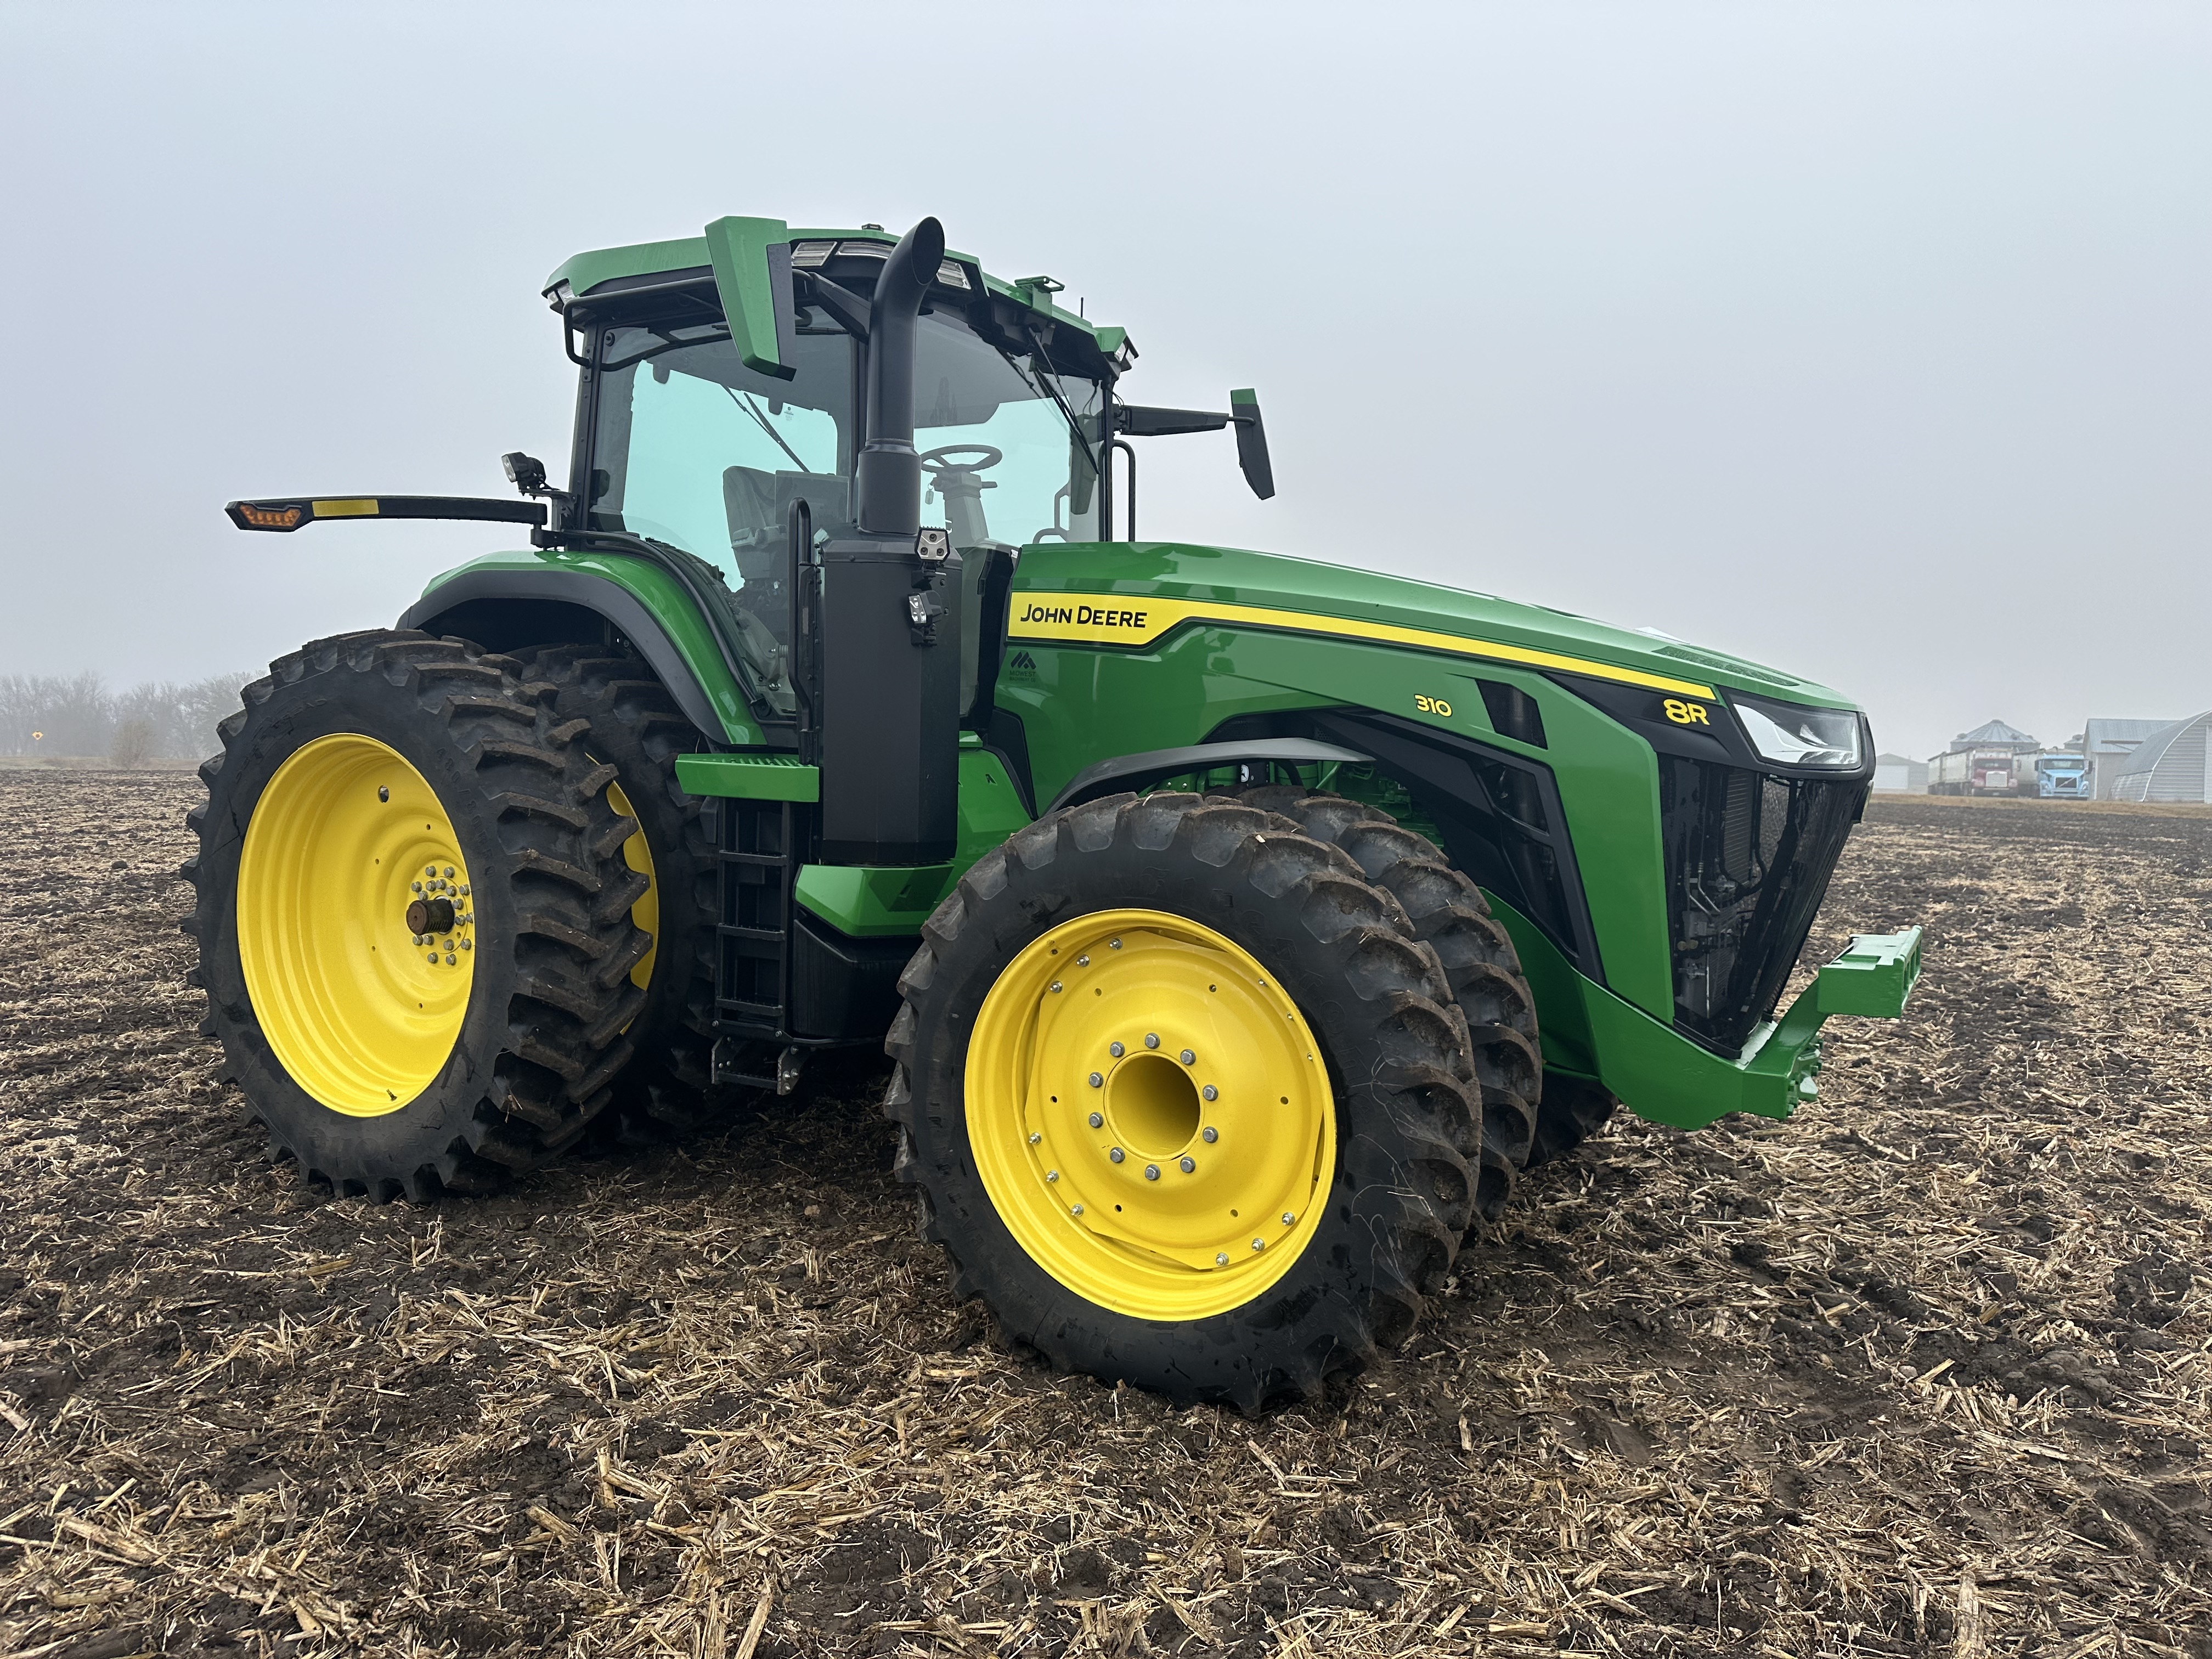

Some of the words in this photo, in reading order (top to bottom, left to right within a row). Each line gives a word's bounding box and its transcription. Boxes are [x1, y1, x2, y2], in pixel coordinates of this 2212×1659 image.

[1020, 604, 1073, 624] JOHN
[1076, 605, 1148, 628] DEERE
[1414, 695, 1452, 718] 310
[1663, 698, 1711, 726] 8R
